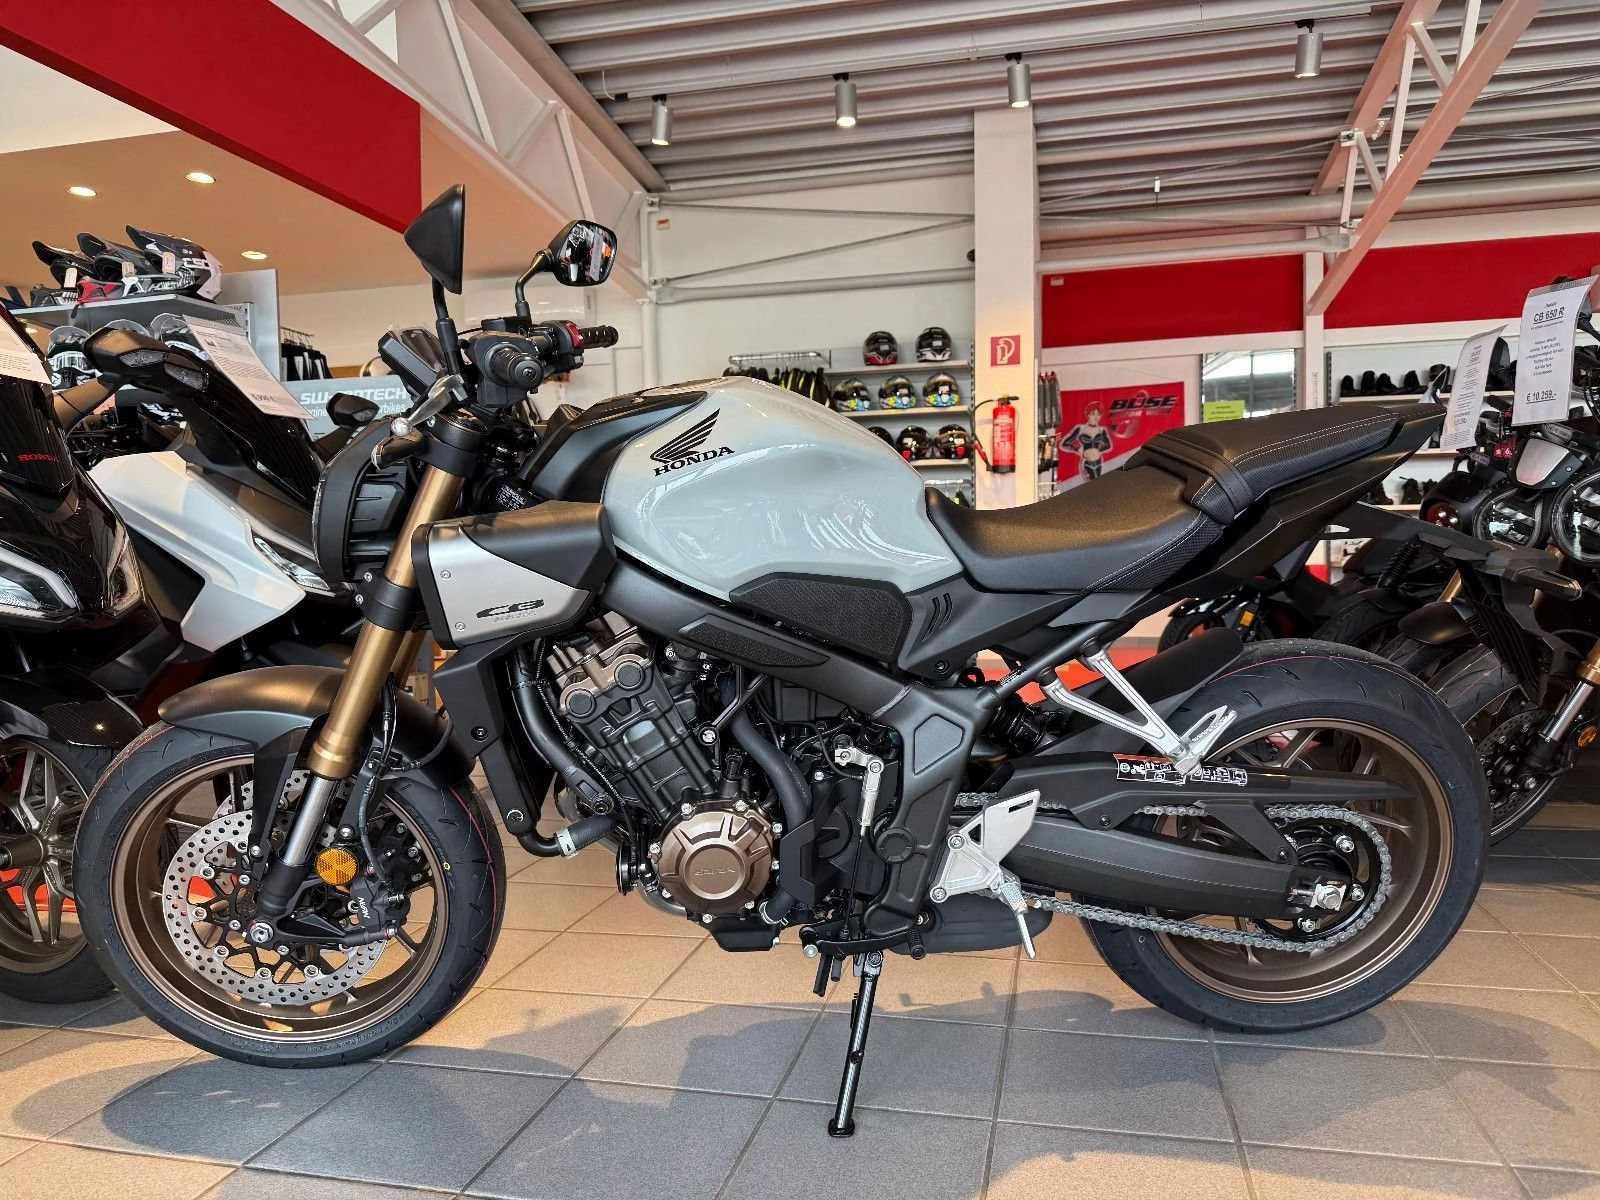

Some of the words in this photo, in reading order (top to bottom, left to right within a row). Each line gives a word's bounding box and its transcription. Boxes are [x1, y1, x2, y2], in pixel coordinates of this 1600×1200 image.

[1533, 314, 1544, 322] CB
[1545, 308, 1559, 319] 650
[1558, 306, 1565, 316] R
[1526, 393, 1531, 401] €
[18, 453, 60, 463] HONDA
[653, 446, 735, 476] HONDA
[476, 599, 545, 618] CB
[357, 896, 371, 919] NISSIN
